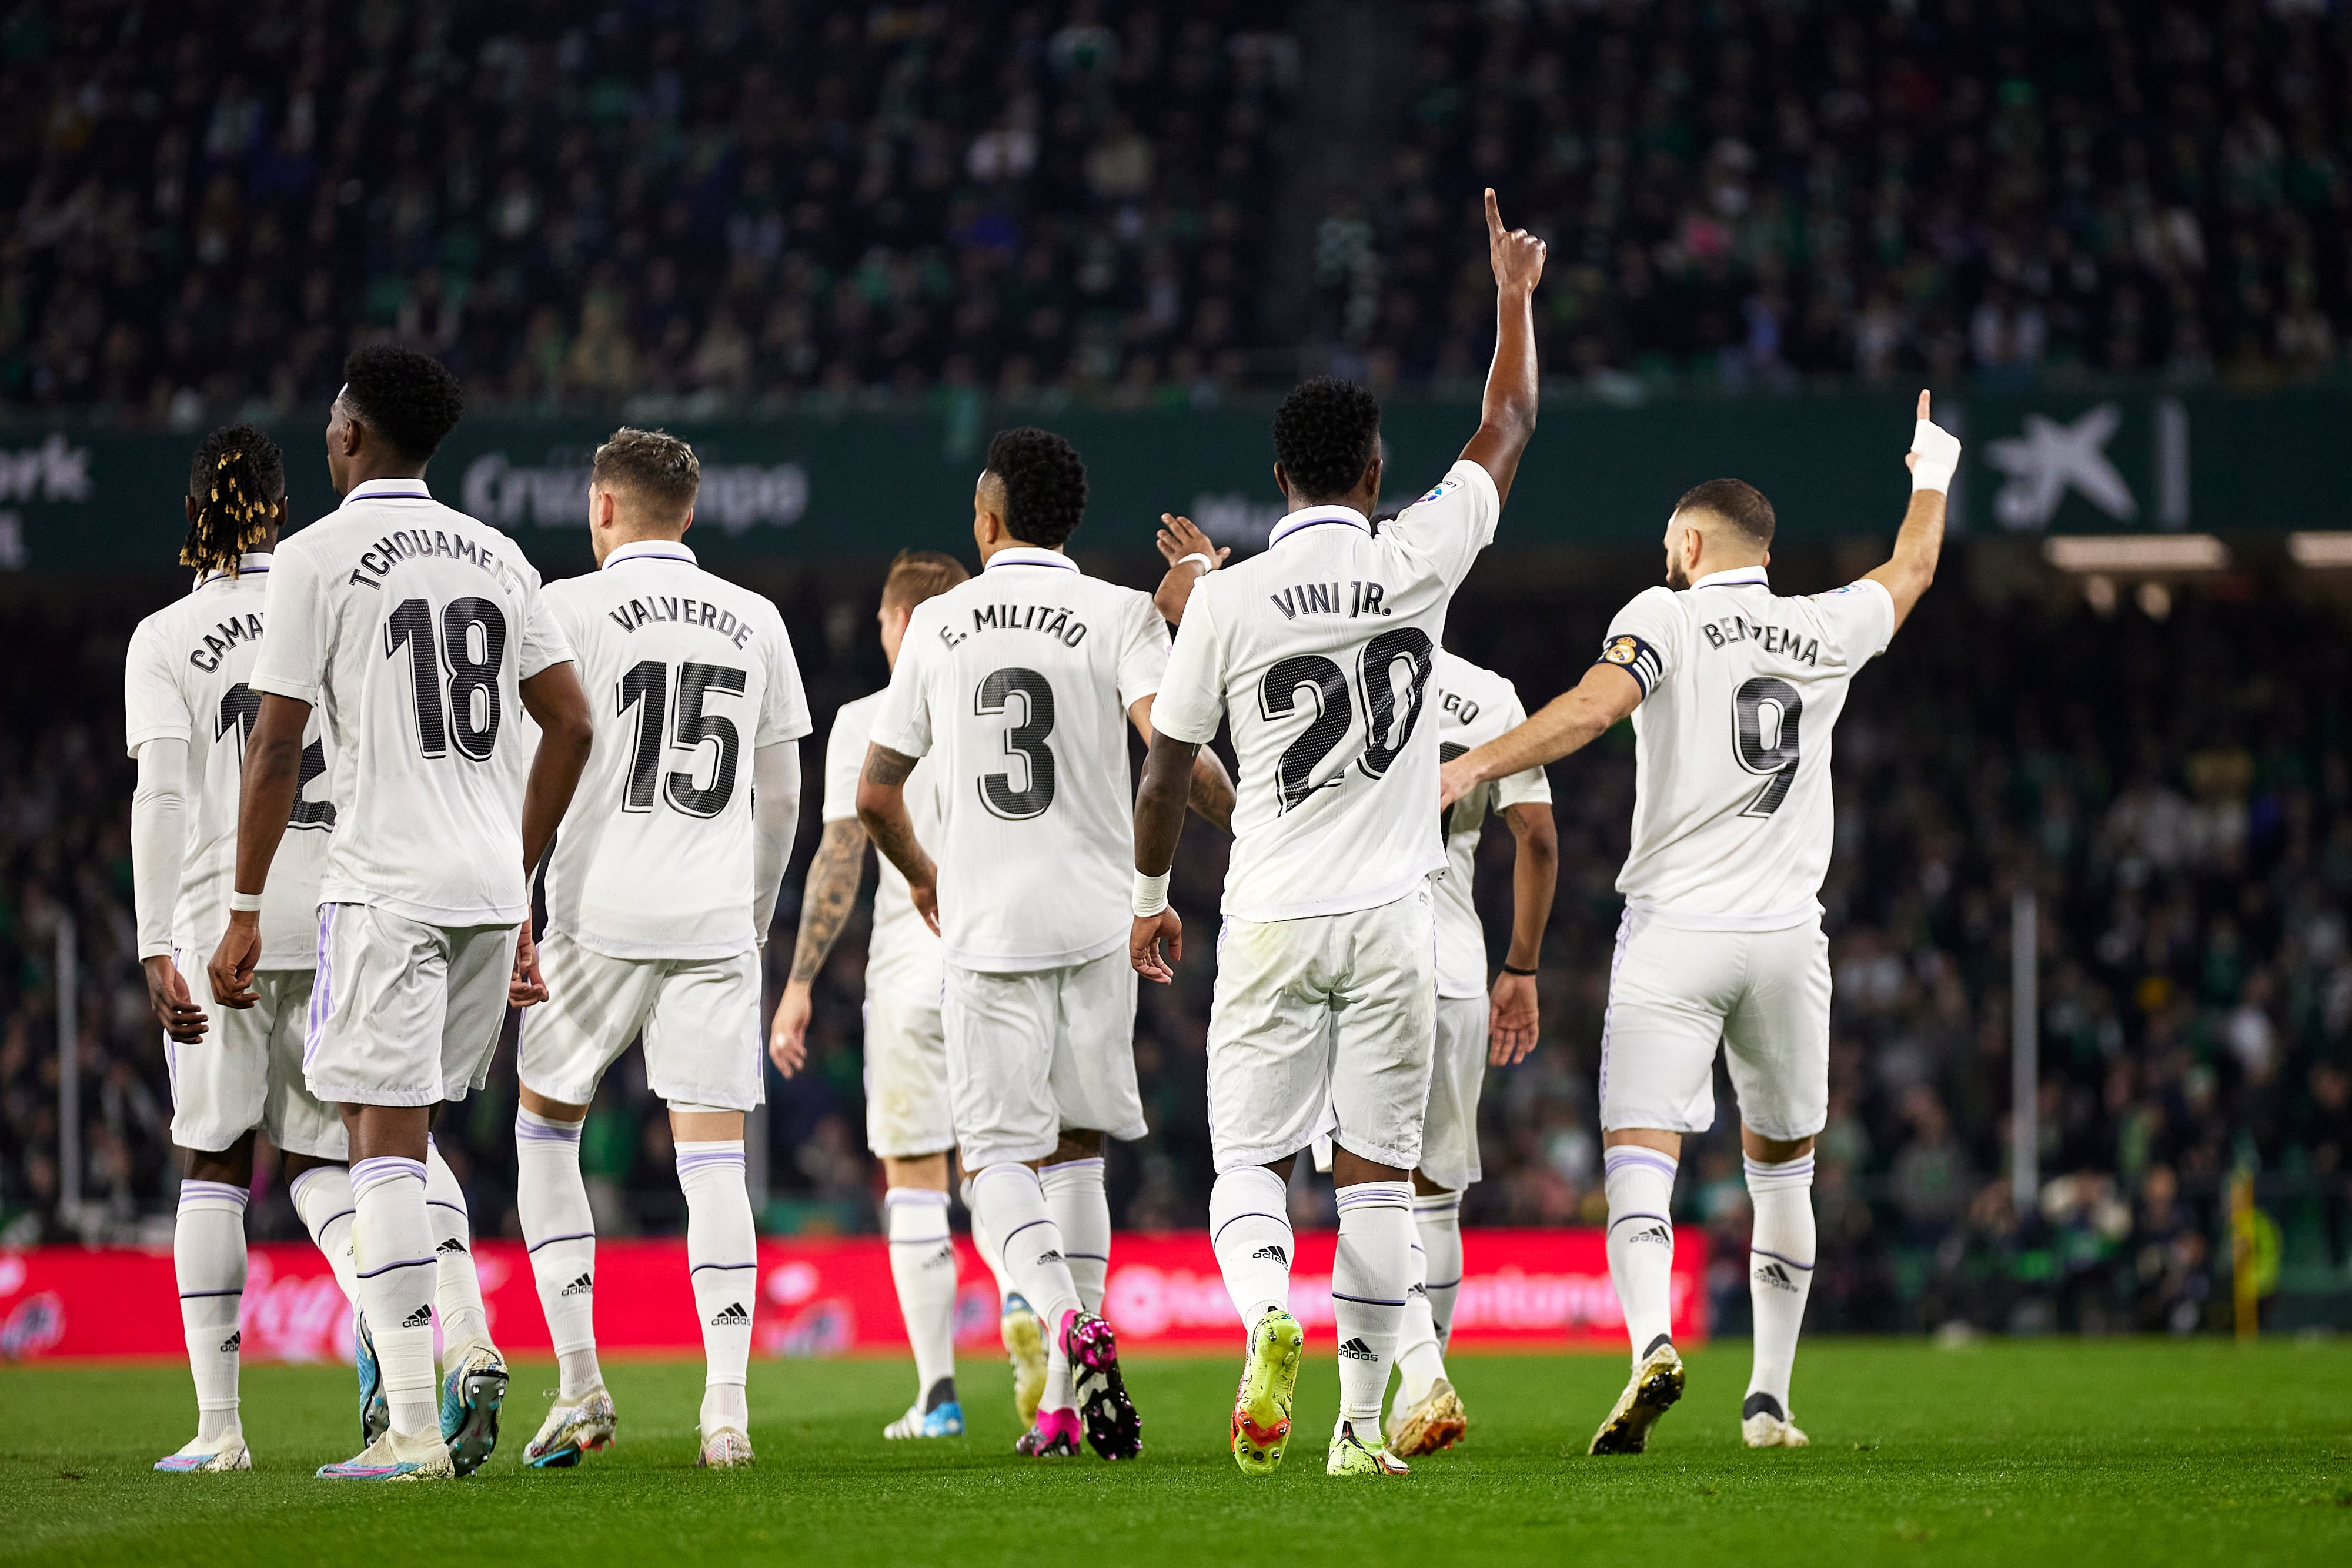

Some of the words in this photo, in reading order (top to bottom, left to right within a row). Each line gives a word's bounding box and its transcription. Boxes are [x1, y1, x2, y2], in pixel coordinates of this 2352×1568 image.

[609, 596, 753, 650] VALVERDE
[939, 625, 967, 651] E.
[973, 604, 1087, 648] MILITÃO
[1270, 581, 1339, 620] VINI
[1349, 581, 1392, 618] JR.
[190, 613, 263, 673] CAMA
[384, 597, 506, 762] 18
[616, 660, 747, 819] 15
[975, 667, 1055, 820] 3
[1258, 627, 1434, 818] 20
[1732, 677, 1802, 818] 9
[711, 1315, 751, 1326] adidas
[1338, 1348, 1378, 1362] adidas
